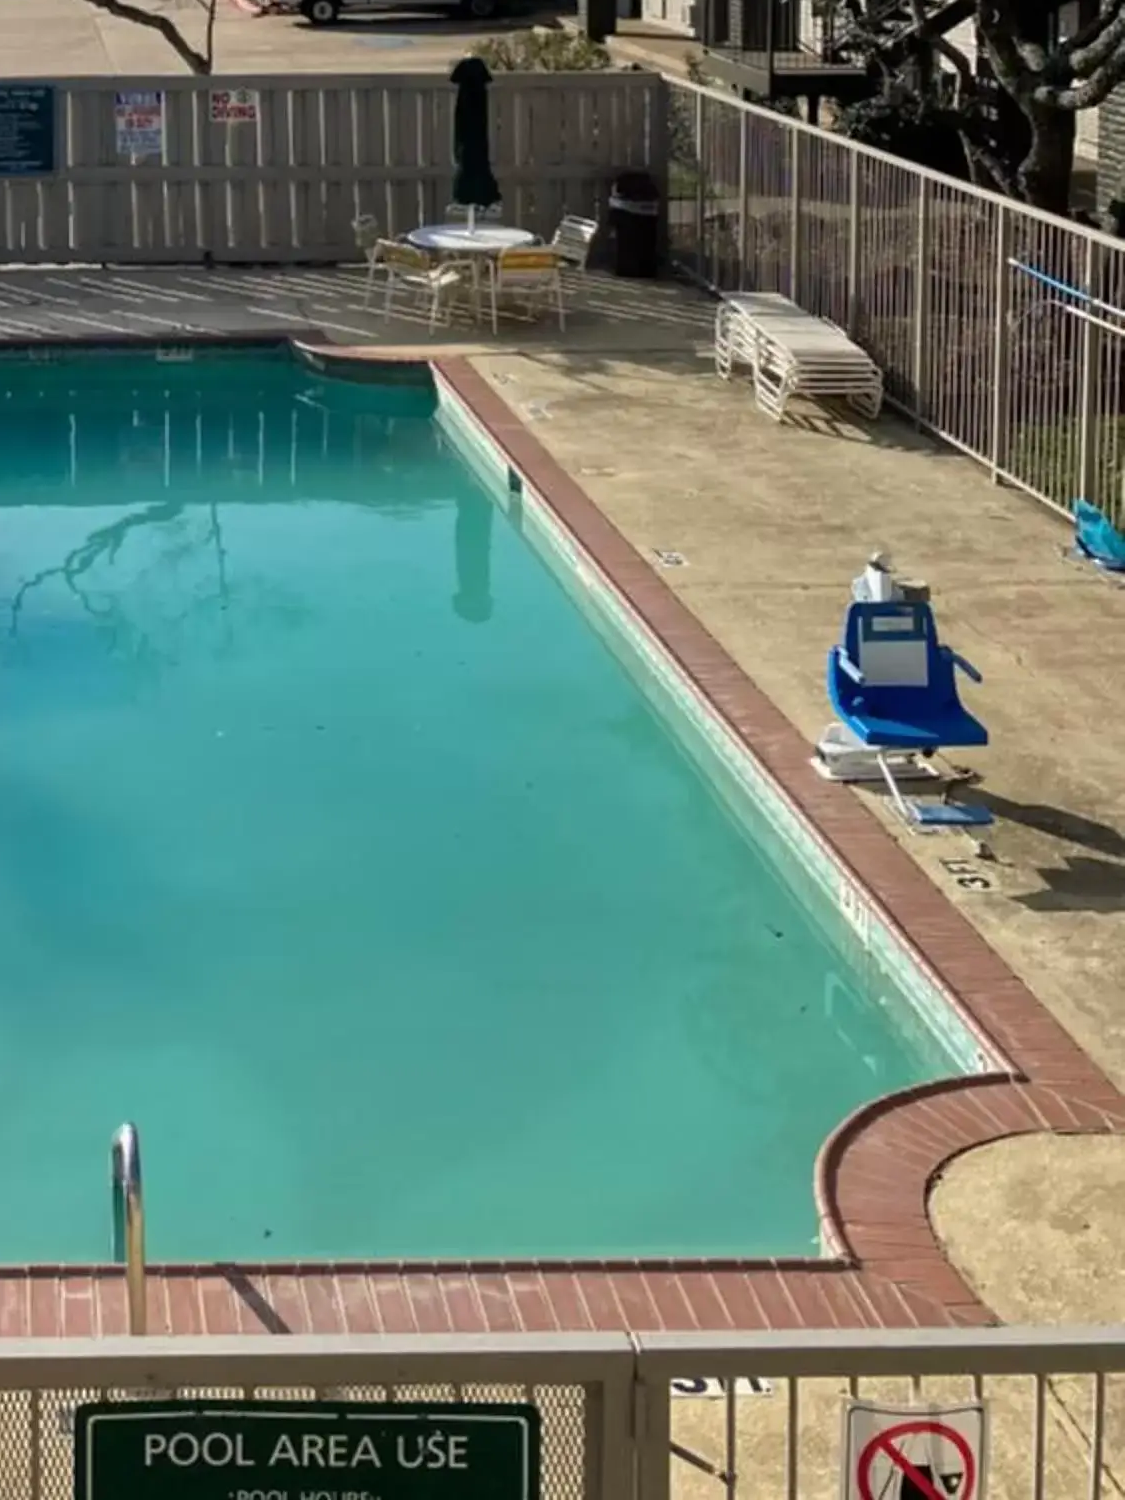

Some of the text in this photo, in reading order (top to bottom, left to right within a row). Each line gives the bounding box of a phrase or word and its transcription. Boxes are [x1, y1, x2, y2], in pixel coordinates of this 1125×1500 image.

[212, 92, 230, 104] NO
[144, 1433, 469, 1469] POOL AREA USE
